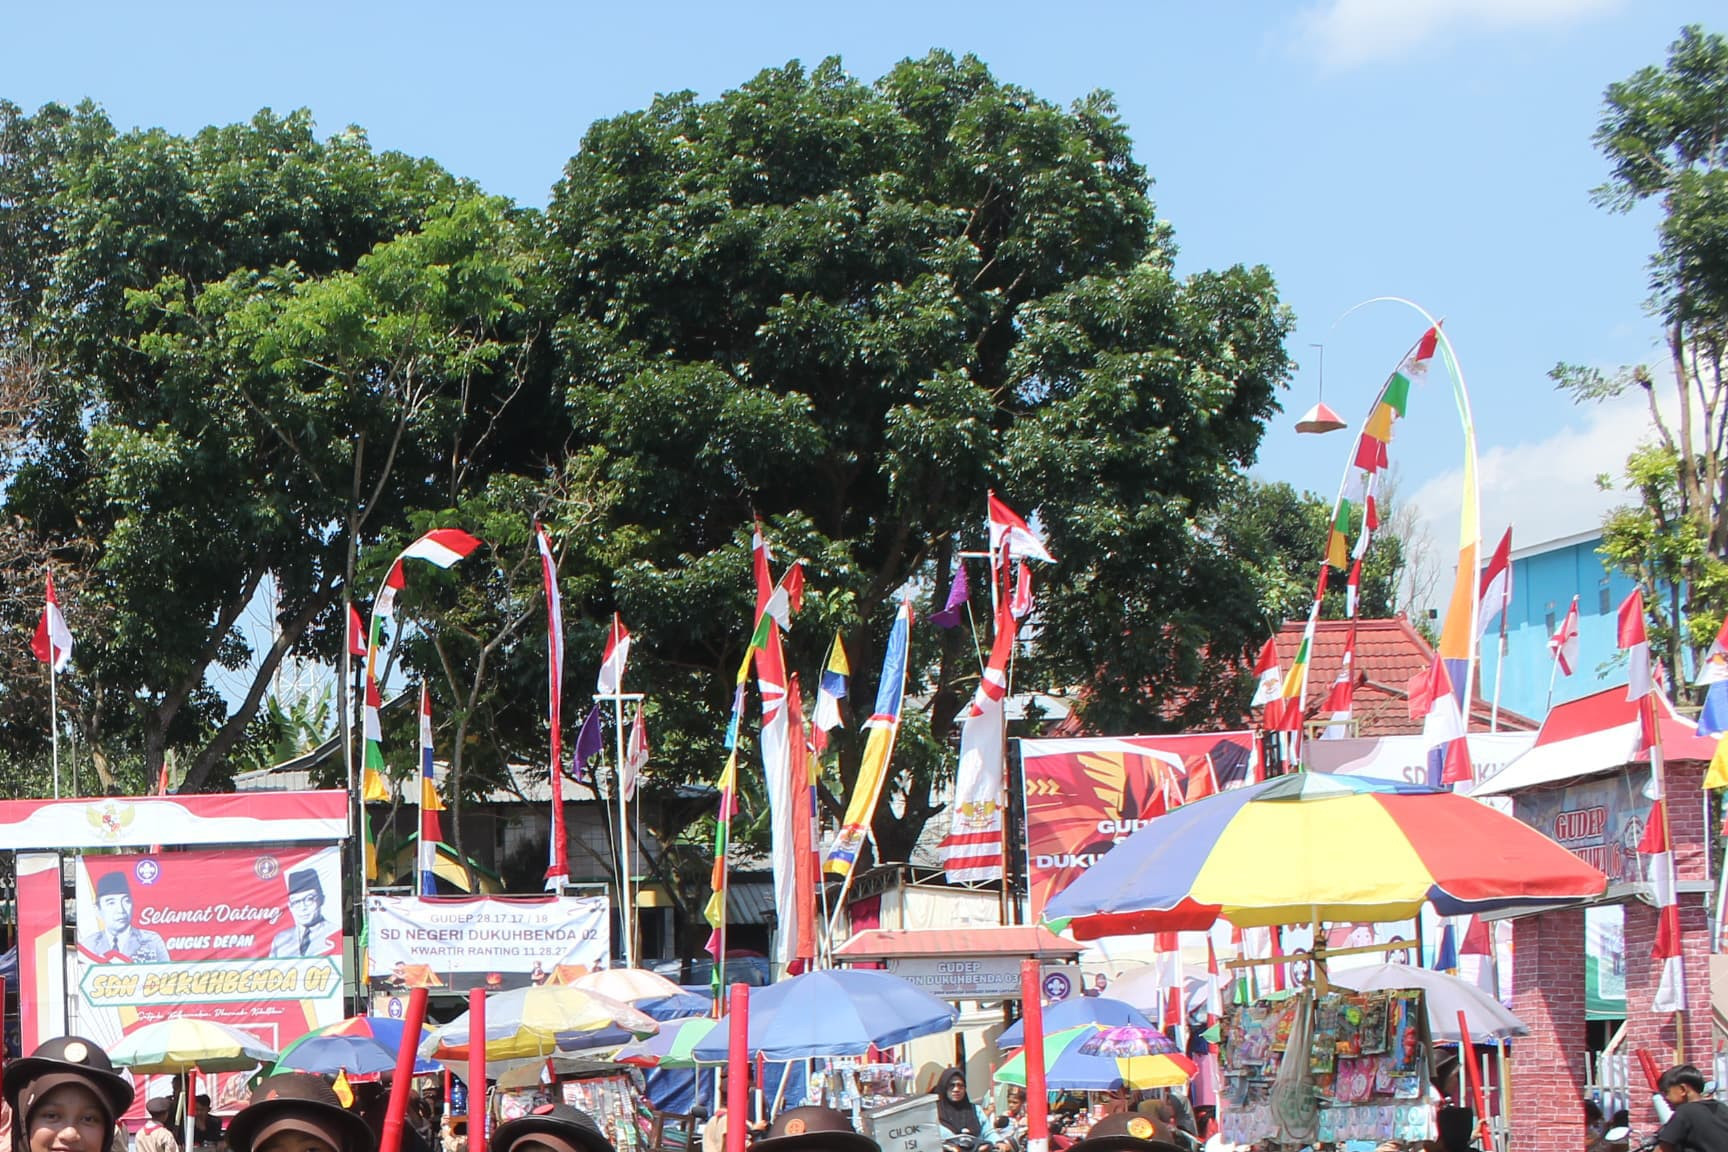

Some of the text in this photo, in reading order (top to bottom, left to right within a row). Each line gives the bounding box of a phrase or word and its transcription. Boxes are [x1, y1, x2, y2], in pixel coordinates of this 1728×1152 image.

[1097, 818, 1155, 834] GUD
[1554, 806, 1608, 843] GUDEP
[1036, 854, 1105, 869] DUKU
[139, 904, 283, 926] Selamat Datang
[430, 914, 473, 924] GUDEP
[380, 928, 597, 941] SD NEGERI DUKUHBENDA 02
[166, 934, 255, 950] GUGUS DEPAN
[411, 946, 464, 956] KWARTIR
[468, 946, 520, 956] RANTING
[937, 962, 982, 973] GUDEP
[91, 965, 332, 999] SDN DUKUHBENDA 01
[926, 974, 1003, 986] DUKUHBENDA
[889, 1125, 921, 1139] CILOK
[904, 1140, 918, 1150] ISI
